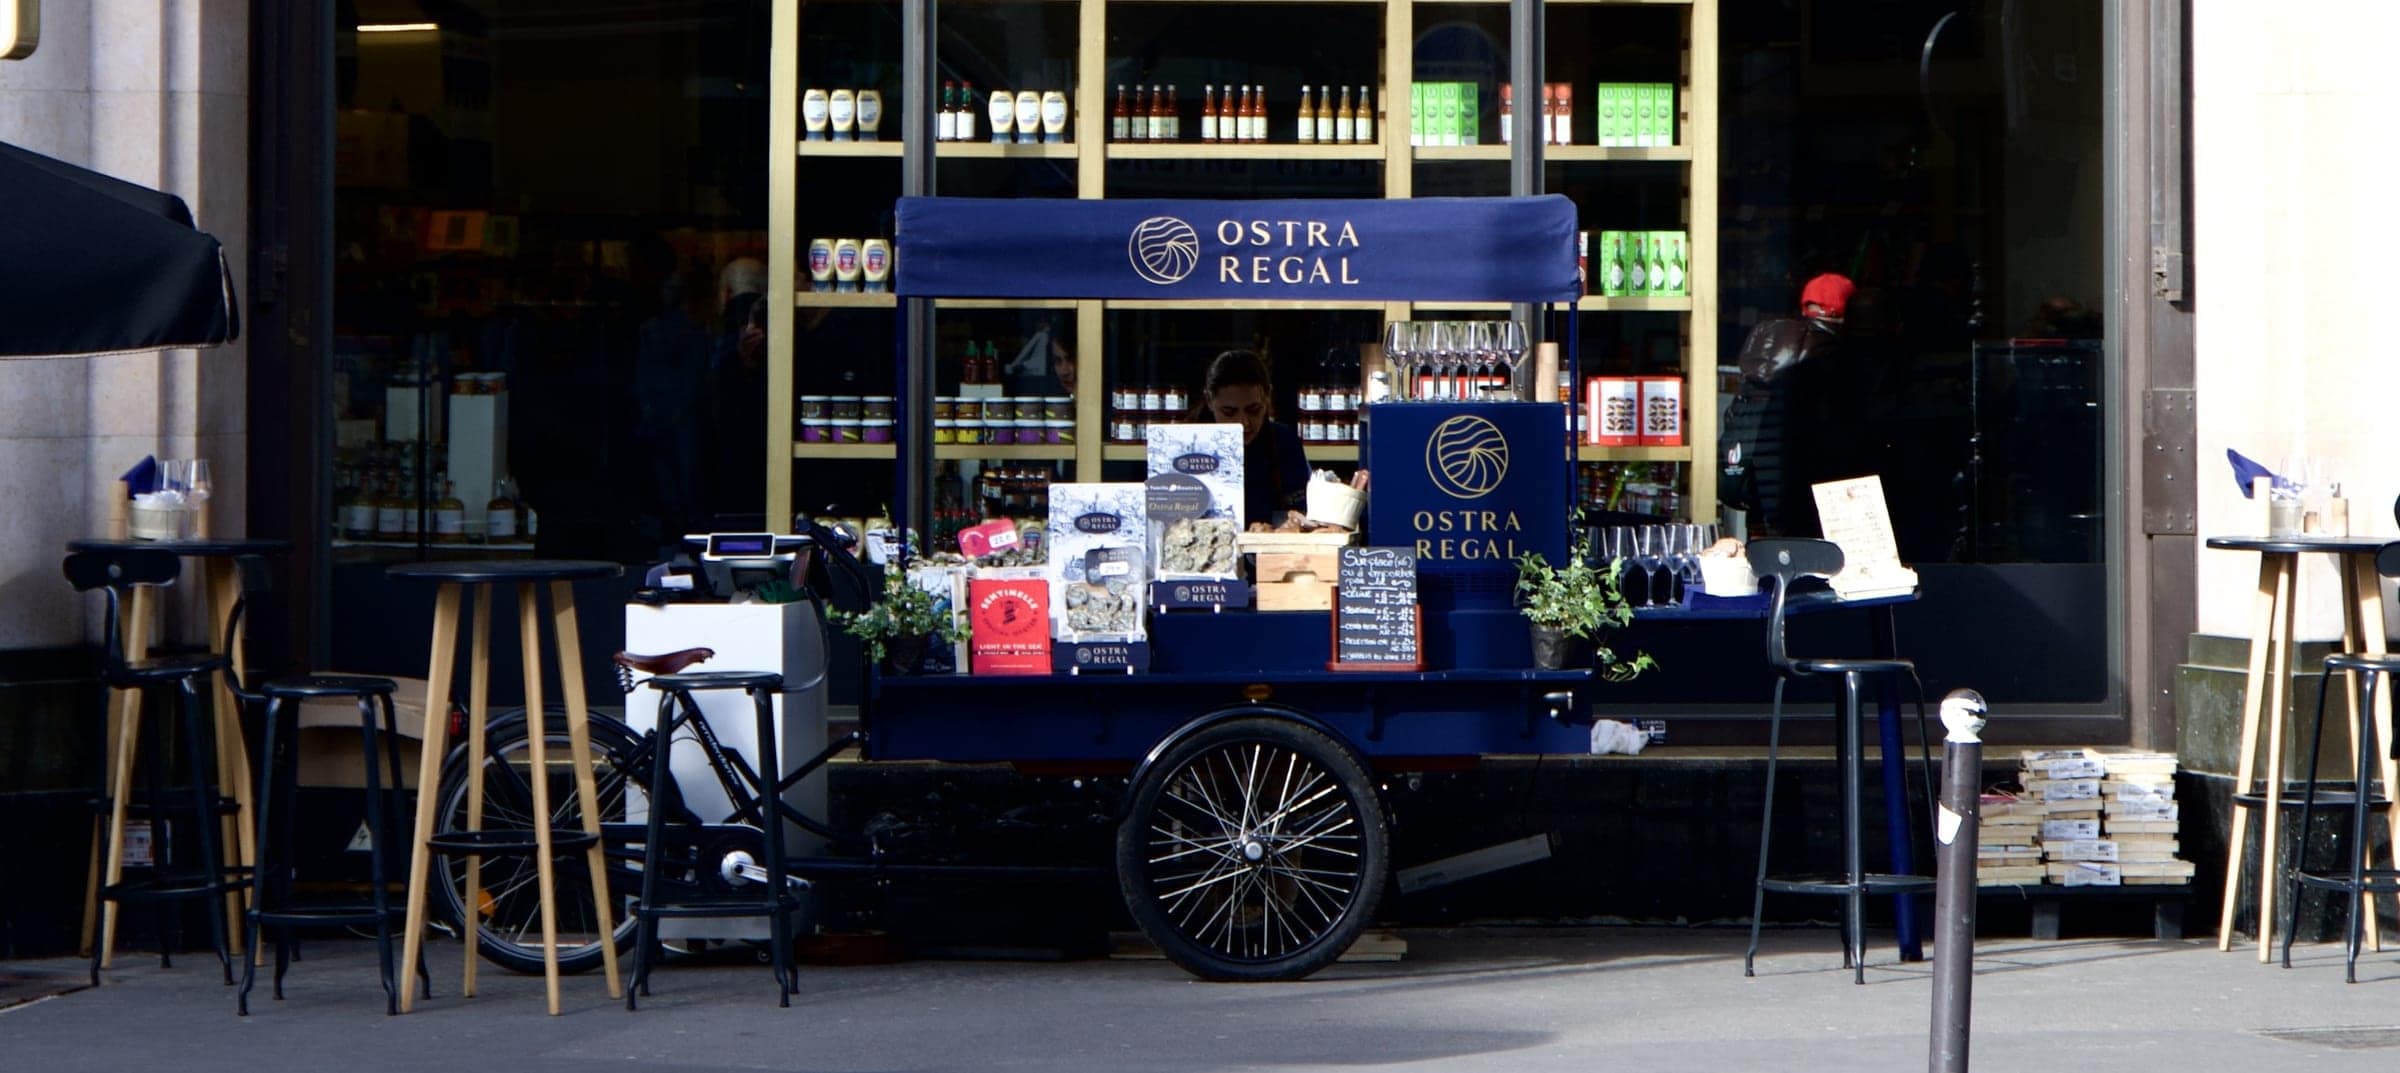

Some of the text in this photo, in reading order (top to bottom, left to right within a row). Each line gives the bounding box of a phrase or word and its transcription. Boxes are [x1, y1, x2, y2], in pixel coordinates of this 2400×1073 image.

[1217, 220, 1359, 247] OSTRA
[1219, 256, 1359, 284] REGAL
[1090, 522, 1117, 530] REGAL
[1413, 510, 1521, 532] OSTRA
[1416, 538, 1521, 560] REGAL
[1191, 585, 1227, 593] OSTRA
[980, 588, 1039, 610] SENTINELLE
[1191, 594, 1227, 602] REGAL
[1093, 647, 1129, 655] OSTRA
[1093, 655, 1129, 664] REGAL
